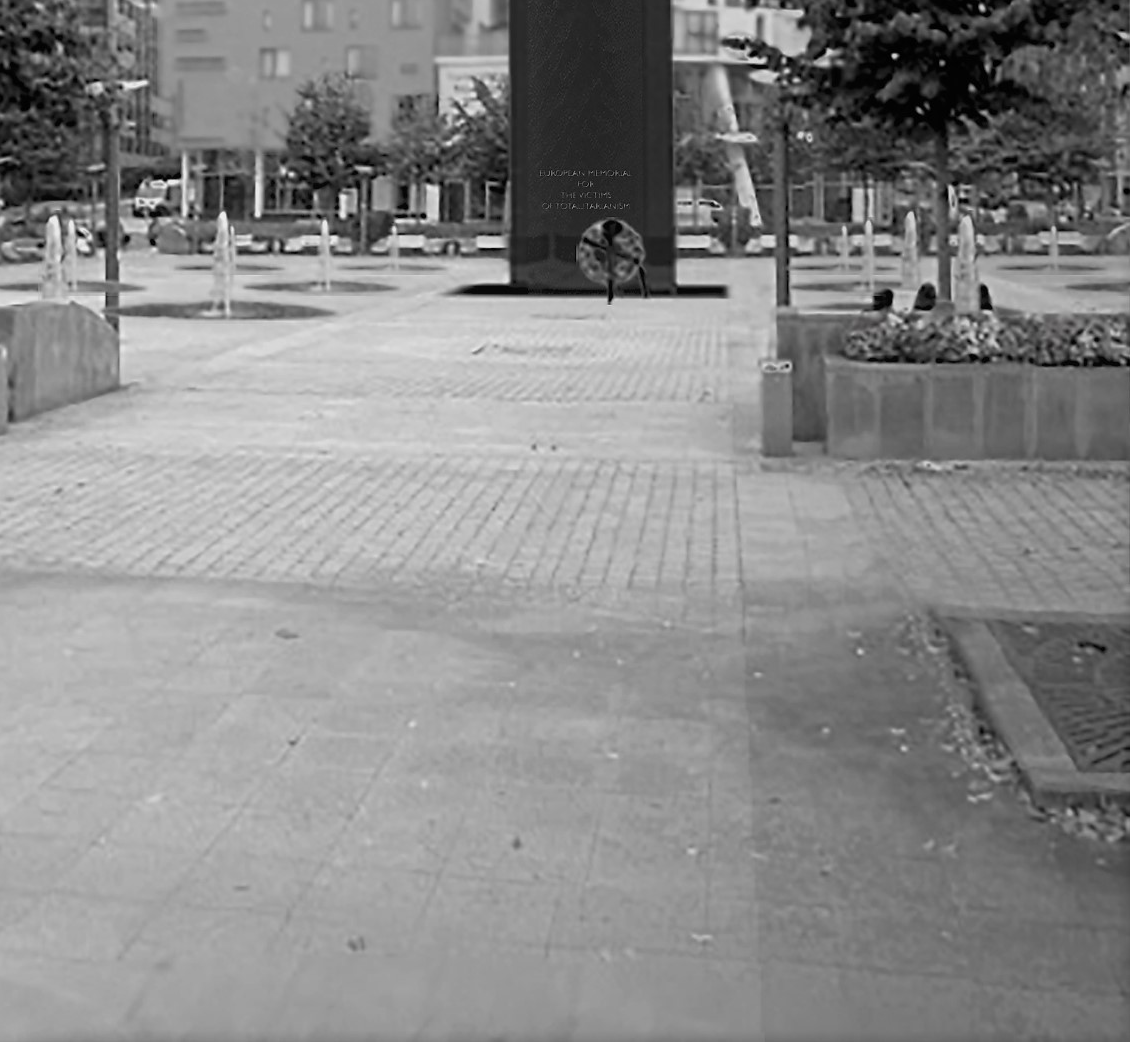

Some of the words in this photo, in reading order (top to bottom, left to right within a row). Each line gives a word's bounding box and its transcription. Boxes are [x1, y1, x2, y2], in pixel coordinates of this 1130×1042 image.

[539, 169, 585, 177] EUROPEAN
[588, 169, 631, 177] MEMORIAL
[577, 180, 594, 188] FOR
[561, 191, 576, 199] THE
[579, 191, 612, 199] VICTIMS
[541, 202, 553, 210] OF
